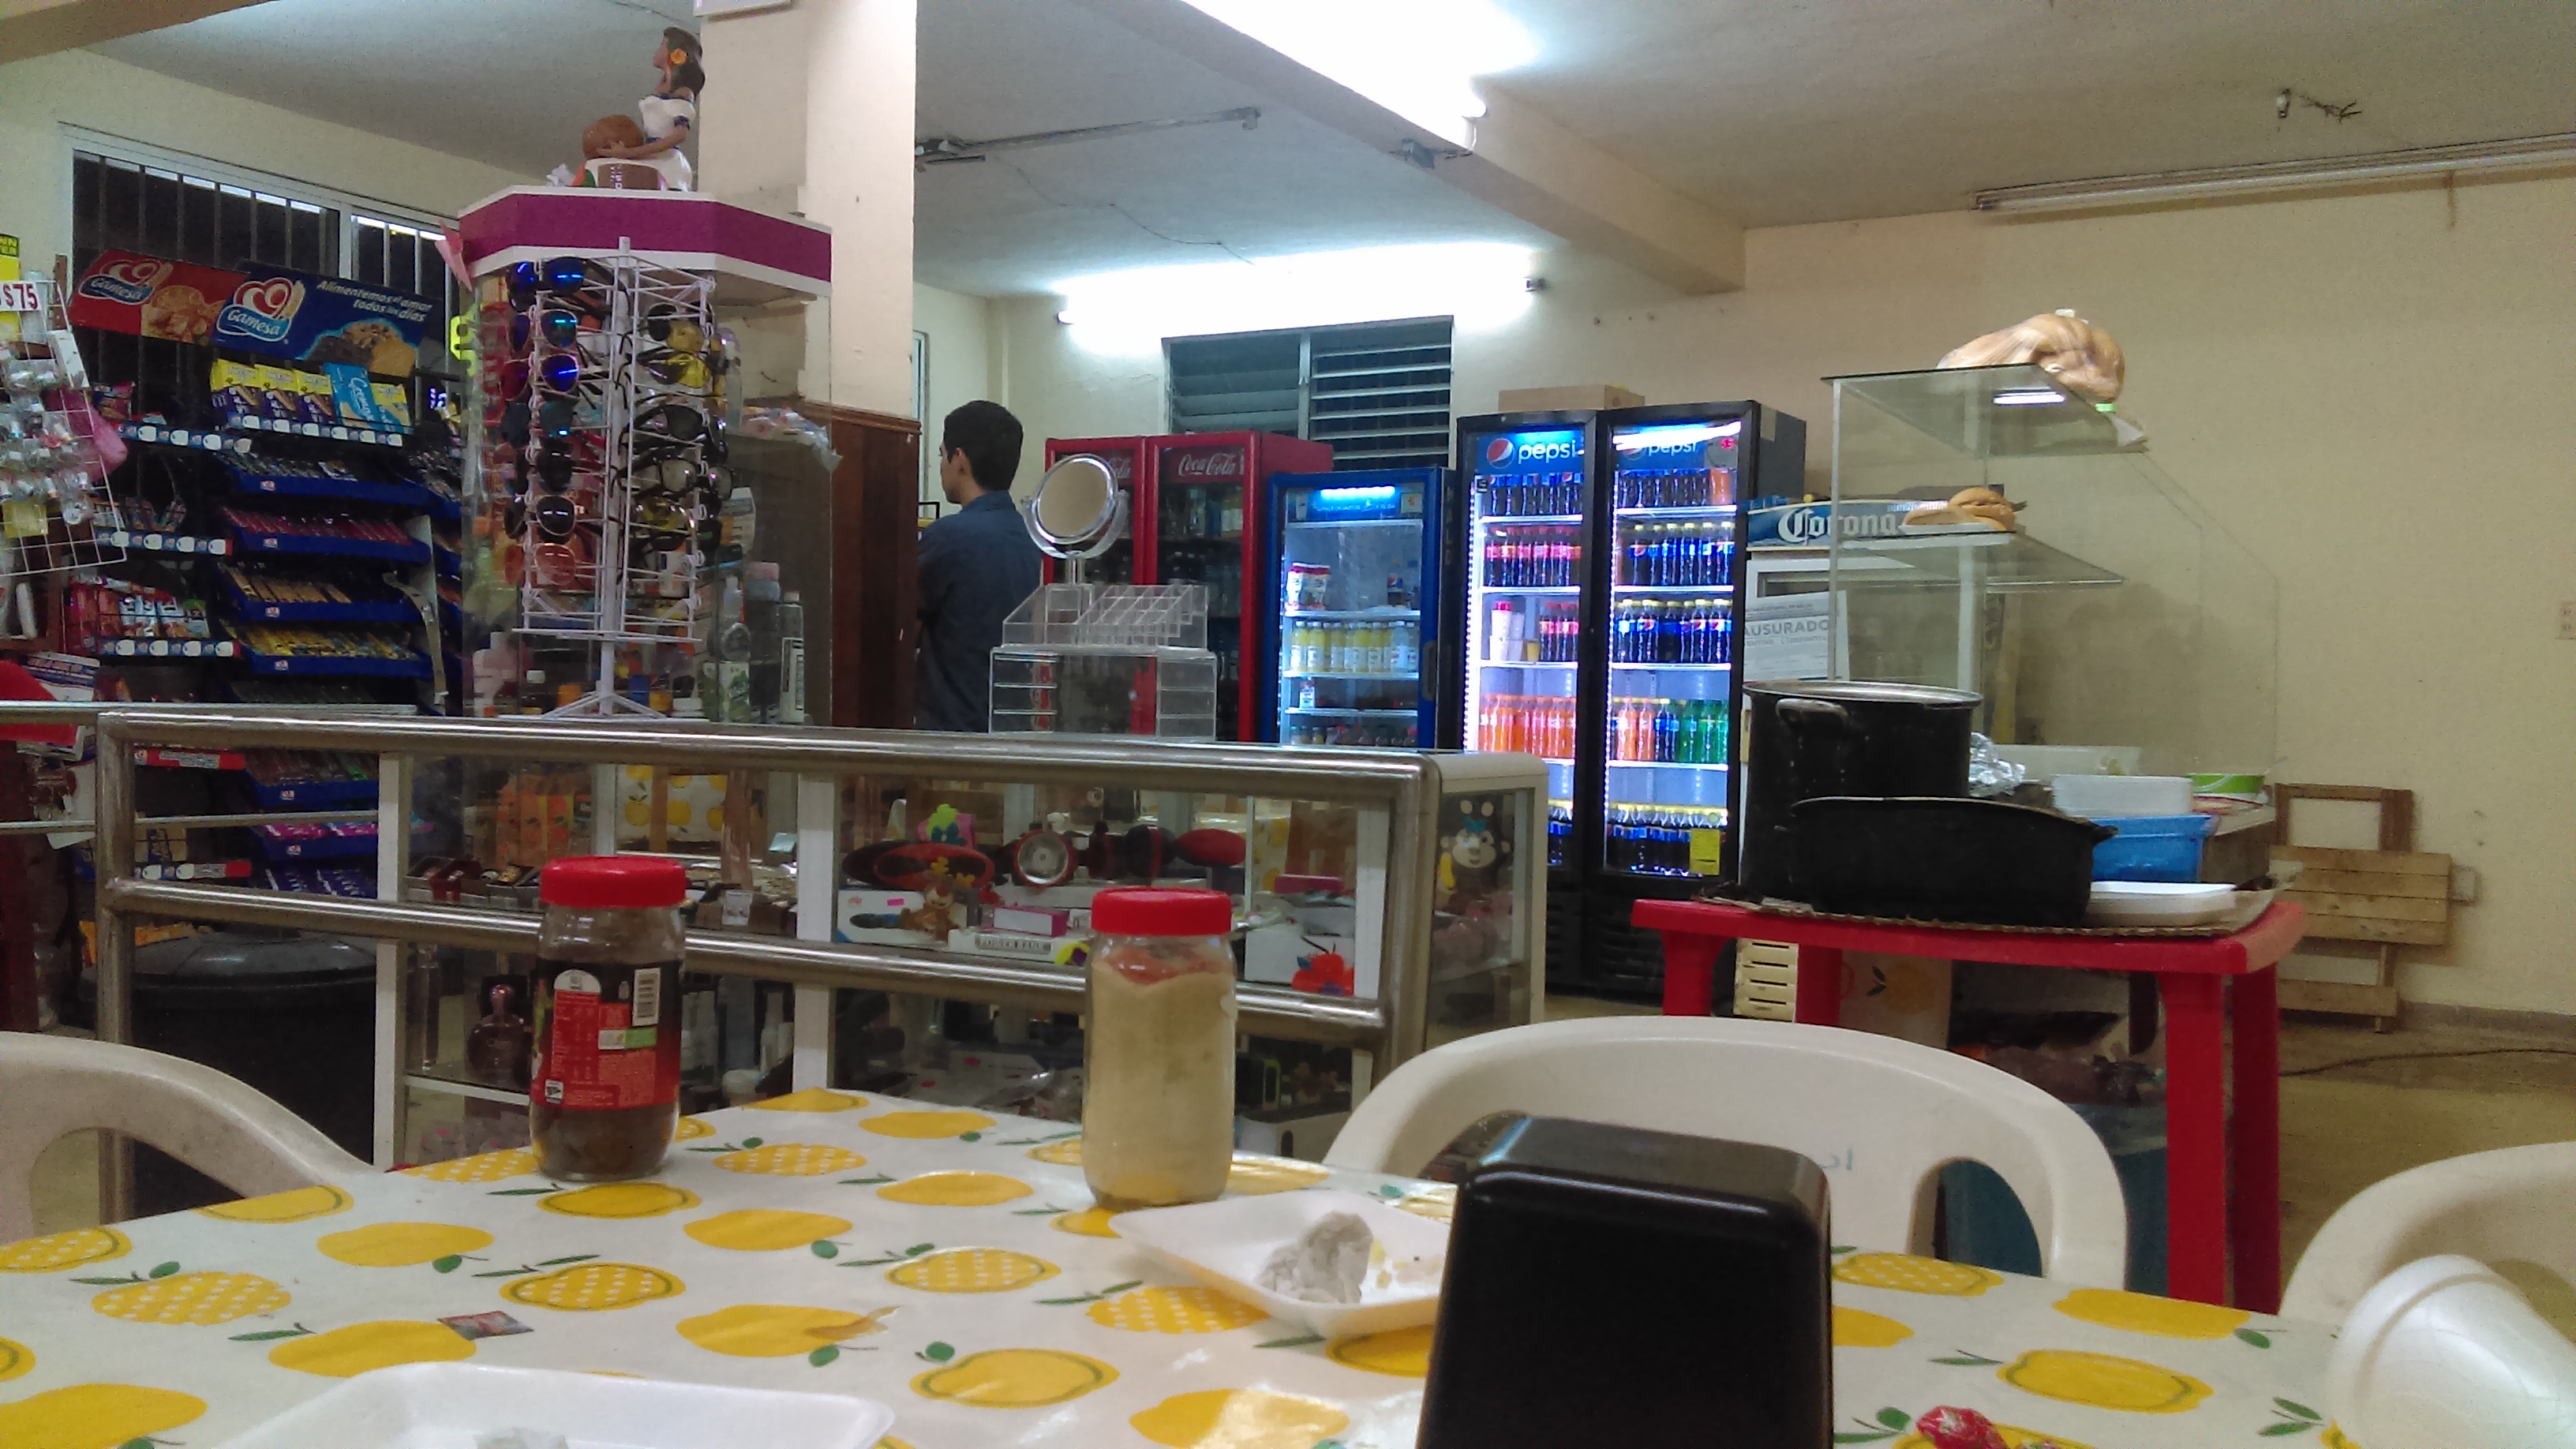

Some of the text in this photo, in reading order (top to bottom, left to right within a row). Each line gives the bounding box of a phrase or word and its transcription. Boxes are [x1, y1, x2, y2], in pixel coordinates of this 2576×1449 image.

[90, 278, 143, 301] Gamesa
[316, 279, 393, 303] Alimentemos
[353, 298, 386, 313] todos
[227, 309, 281, 336] Gamesa
[1518, 439, 1576, 465] pepsi
